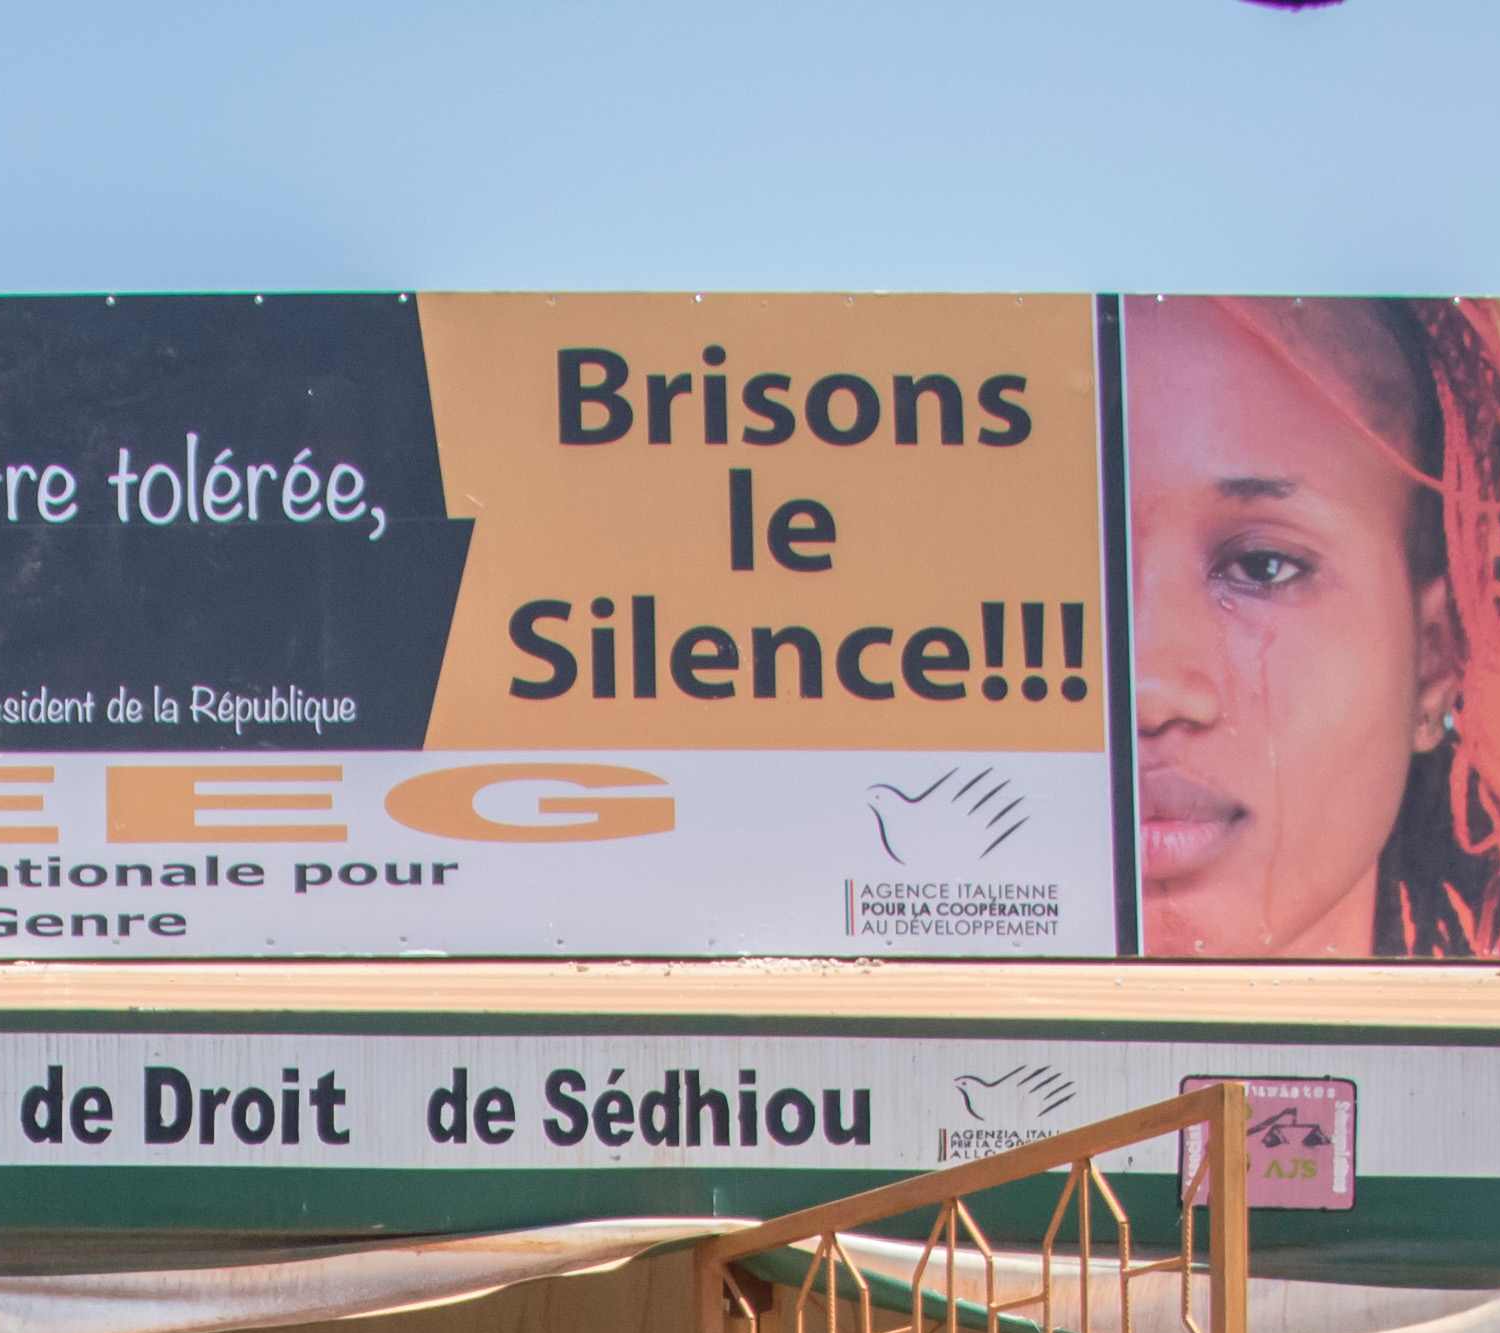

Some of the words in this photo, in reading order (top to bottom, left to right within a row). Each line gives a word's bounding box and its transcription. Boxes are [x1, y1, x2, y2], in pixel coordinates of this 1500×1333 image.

[558, 345, 1032, 446] Brisons
[108, 432, 385, 540] tolérée,
[729, 468, 836, 571] le
[510, 595, 1087, 701] Silence!!!
[107, 686, 142, 723] de
[154, 686, 178, 723] la
[190, 685, 355, 734] République
[295, 863, 458, 893] pour
[860, 884, 950, 900] AGENCE
[957, 884, 1059, 900] ITALIENNE
[861, 903, 906, 917] POUR
[911, 903, 932, 917] LA
[936, 897, 1059, 917] COOPÉRATION
[861, 920, 888, 936] AU
[895, 915, 1059, 936] DÉVELOPPEMENT
[21, 1065, 112, 1144] de
[144, 1066, 349, 1144] Droit
[428, 1068, 515, 1144] de
[544, 1069, 870, 1146] Sédhiou
[950, 1129, 1020, 1140] AGENZIA
[1264, 1158, 1319, 1180] AJS
